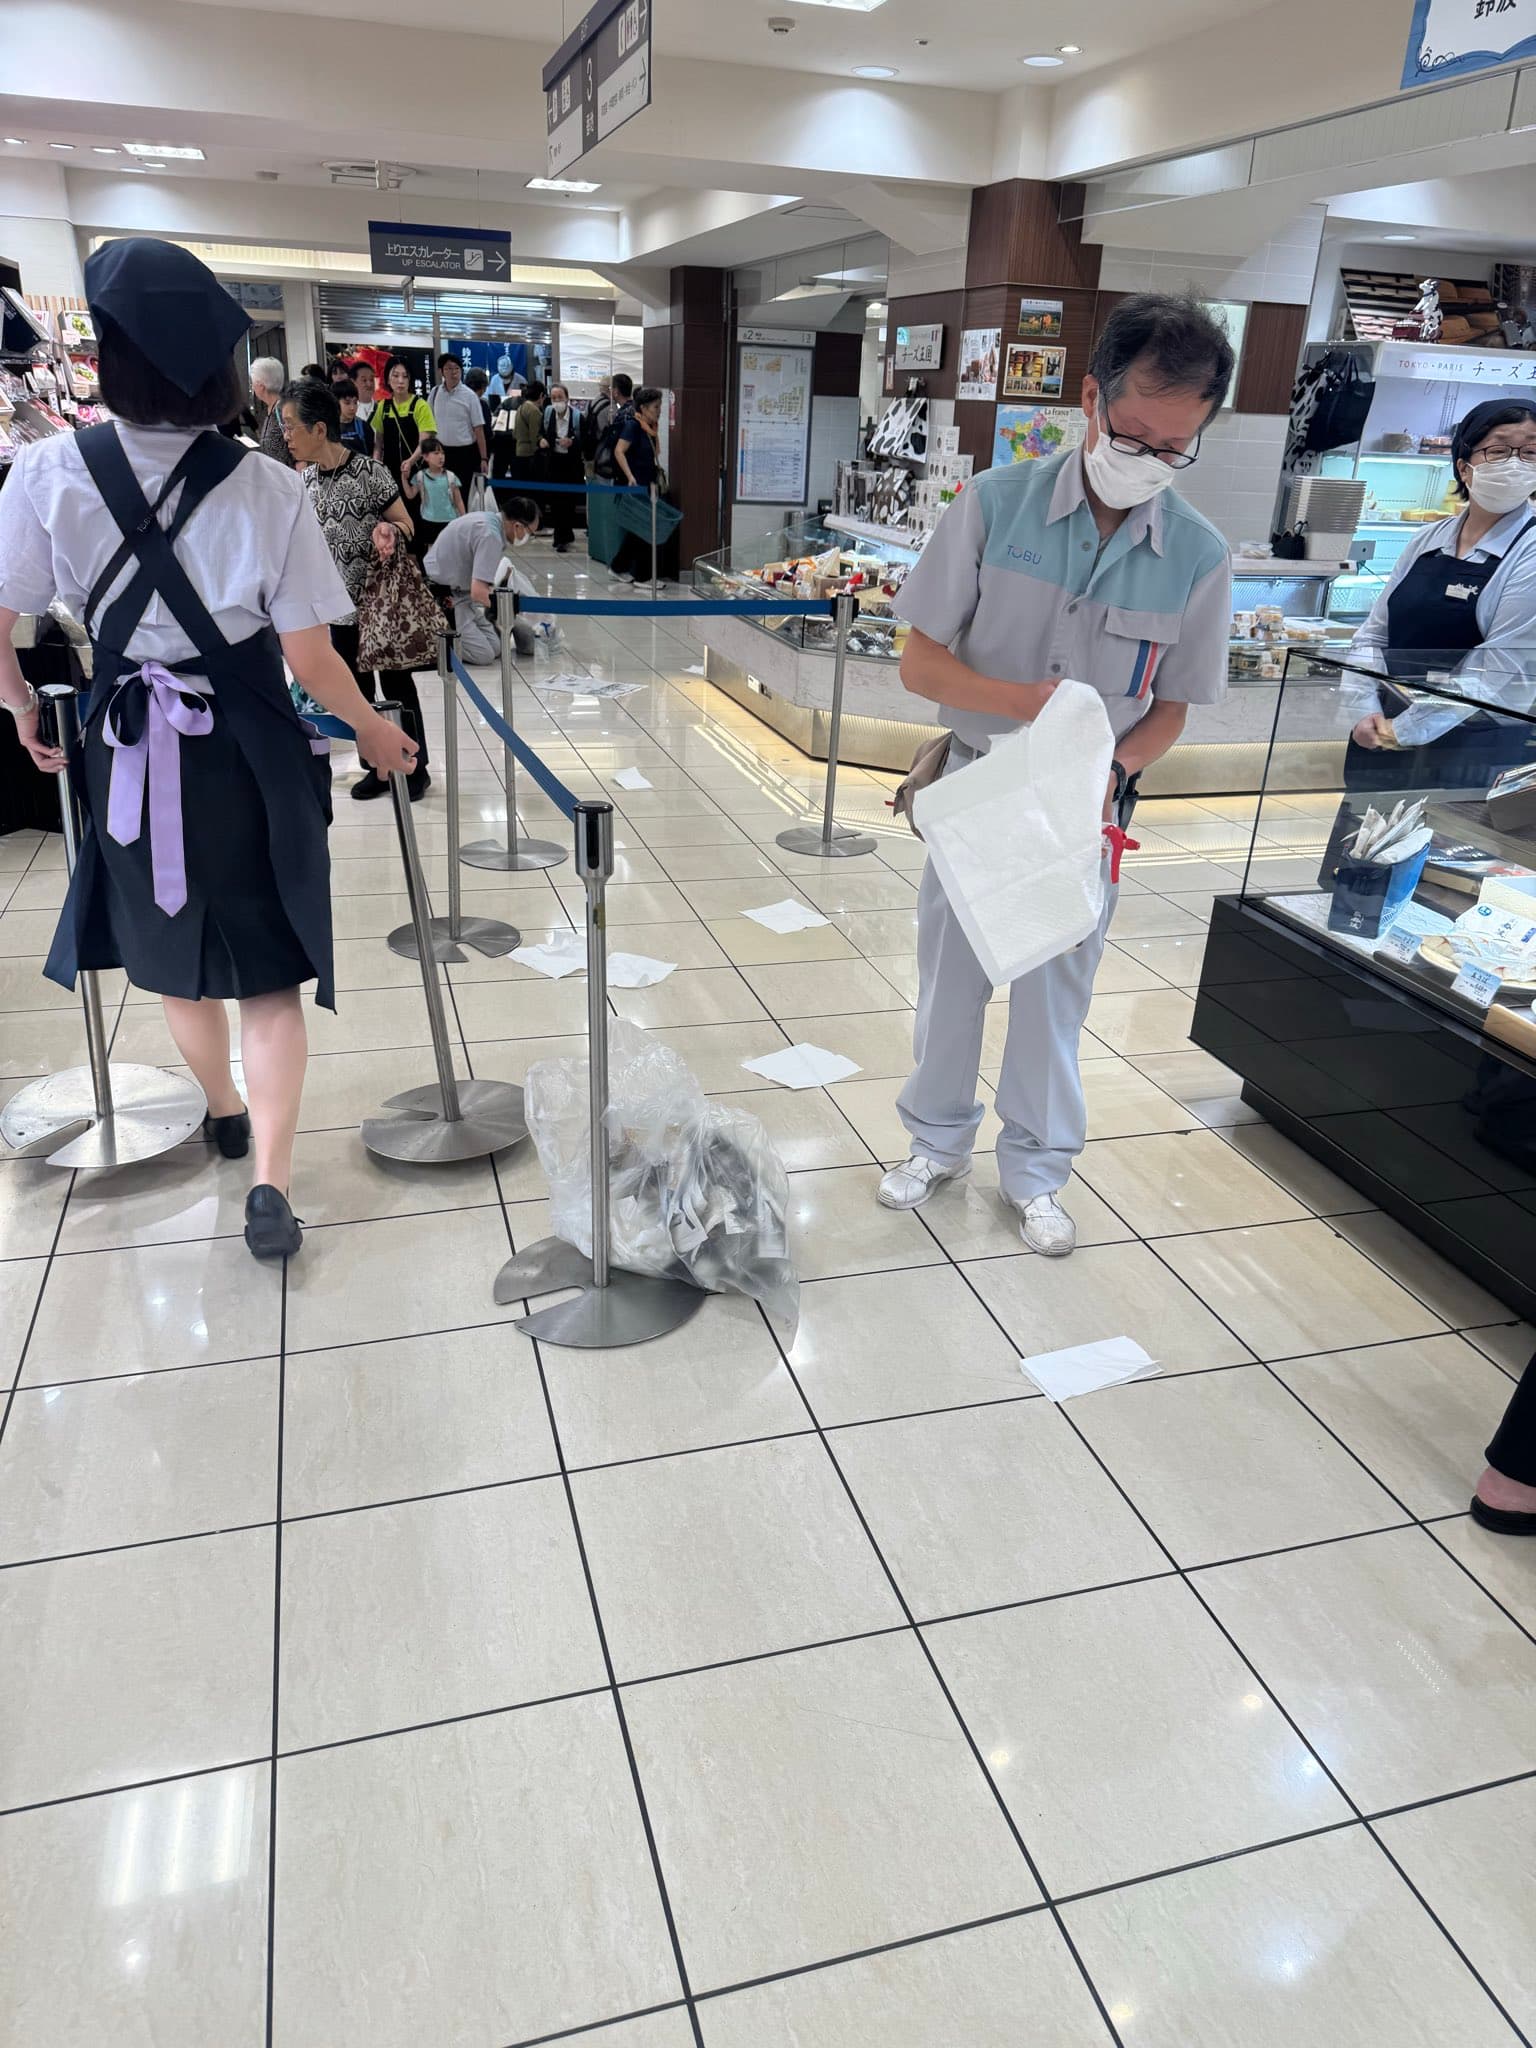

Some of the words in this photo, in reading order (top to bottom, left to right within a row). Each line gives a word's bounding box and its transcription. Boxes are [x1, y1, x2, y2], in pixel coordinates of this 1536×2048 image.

[586, 57, 593, 102] 3
[384, 243, 461, 260] 上りエスカレーター
[401, 258, 413, 267] UP
[415, 259, 461, 270] ESCALATOR
[901, 344, 933, 363] チーズ王国
[1007, 544, 1042, 565] TOBU
